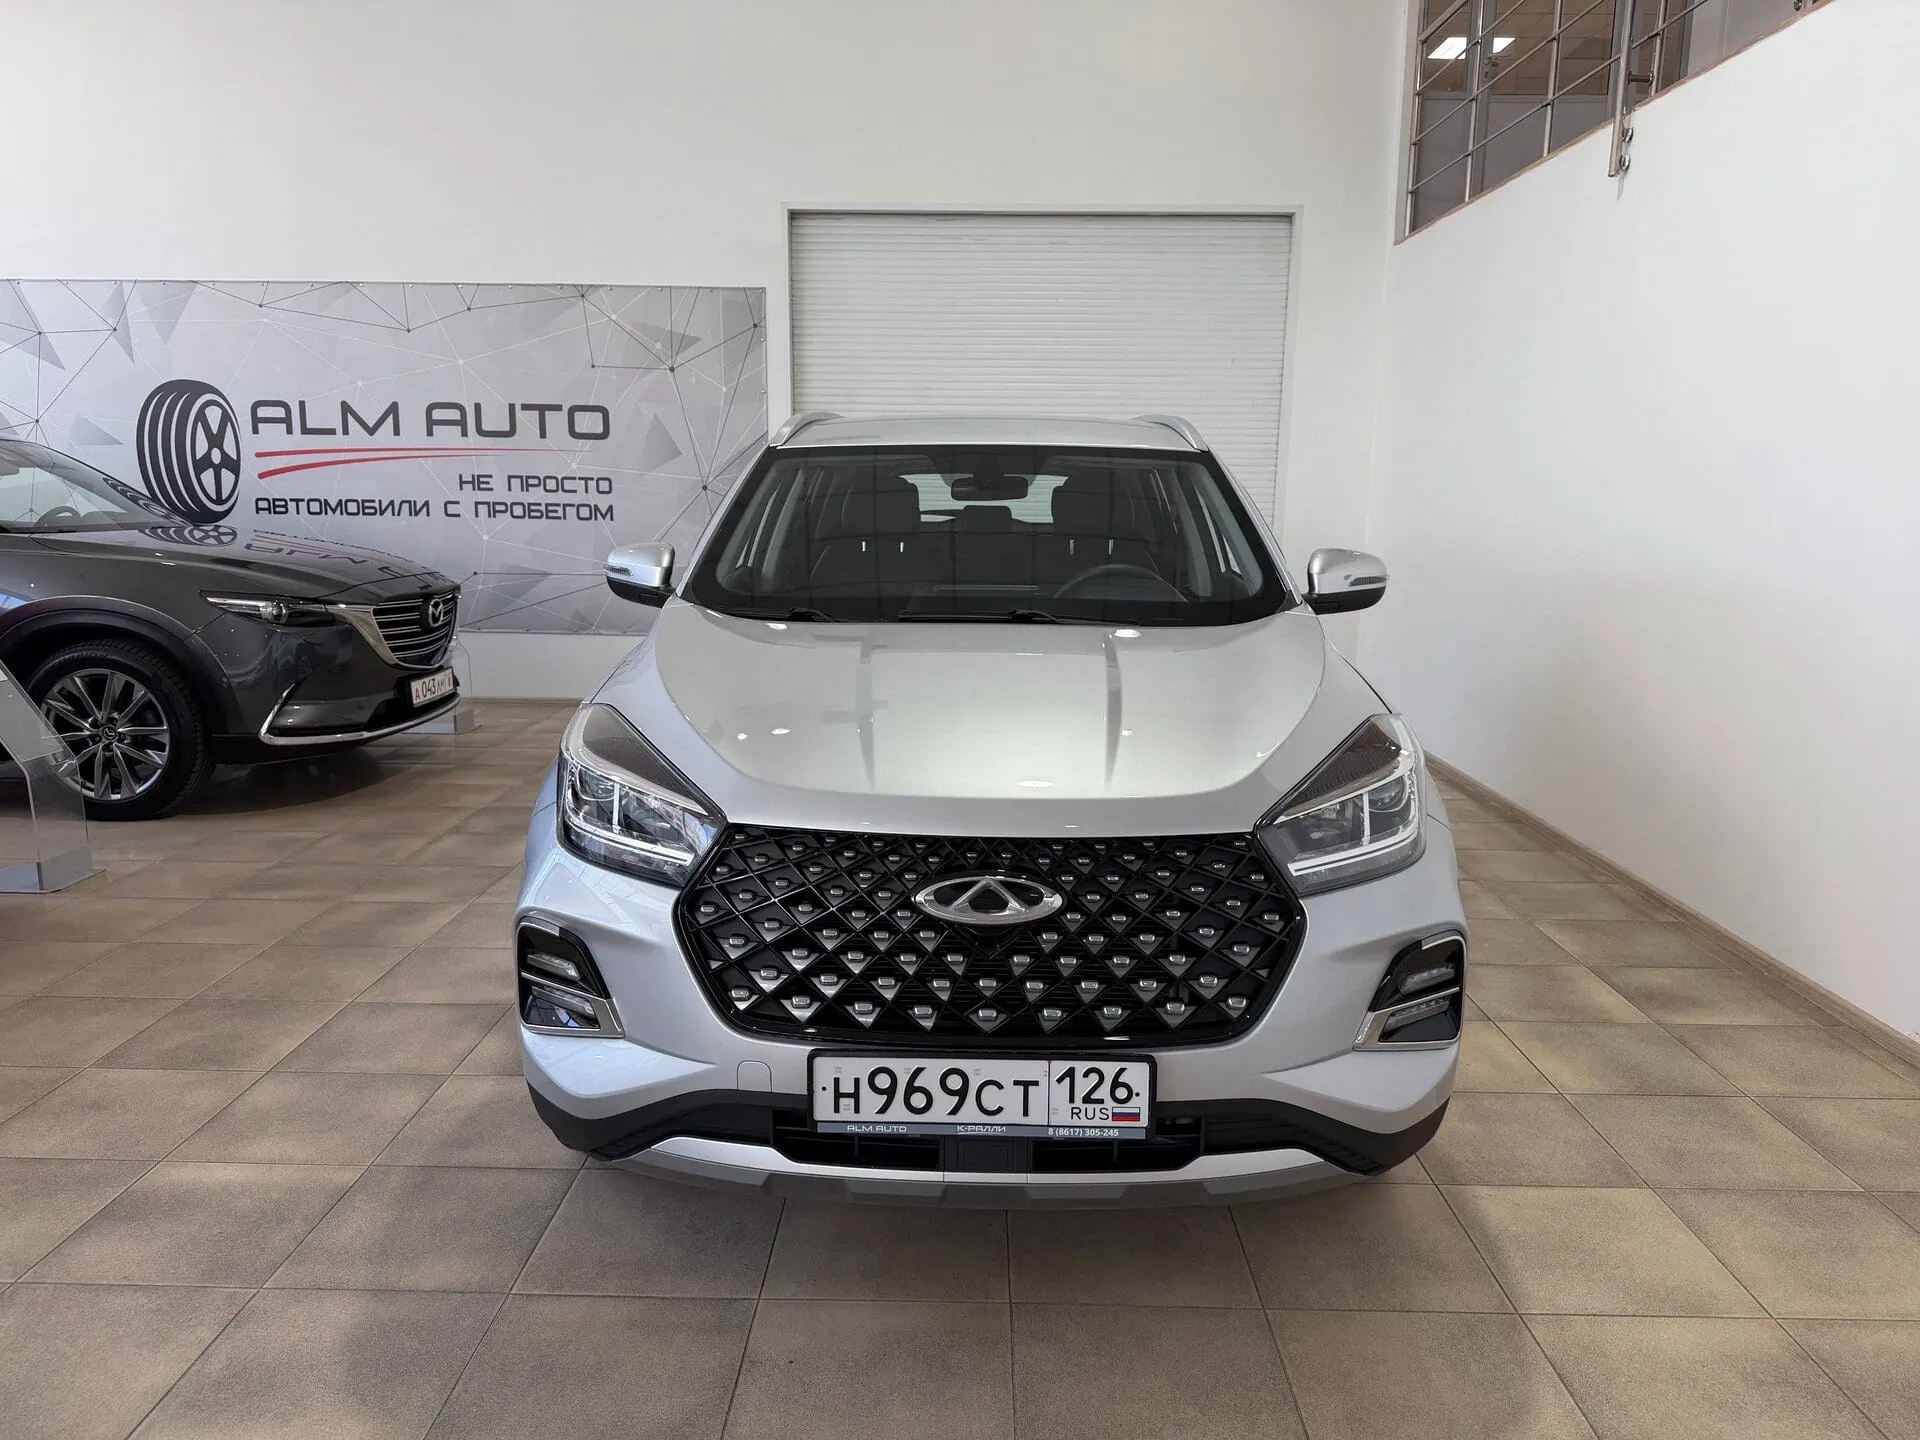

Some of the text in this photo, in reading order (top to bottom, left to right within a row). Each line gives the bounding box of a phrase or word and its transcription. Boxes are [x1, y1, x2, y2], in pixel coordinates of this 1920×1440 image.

[250, 399, 610, 441] ALM AUTO
[458, 474, 613, 495] НЕ ПРОСТО
[255, 498, 615, 522] АВТОМОБИЛИ С ПРОБЕГОМ
[1055, 1066, 1134, 1105] 126
[1070, 1107, 1110, 1121] RUS
[876, 1125, 907, 1133] AUTO
[1048, 1128, 1119, 1137] 8 (8617) 305-245
